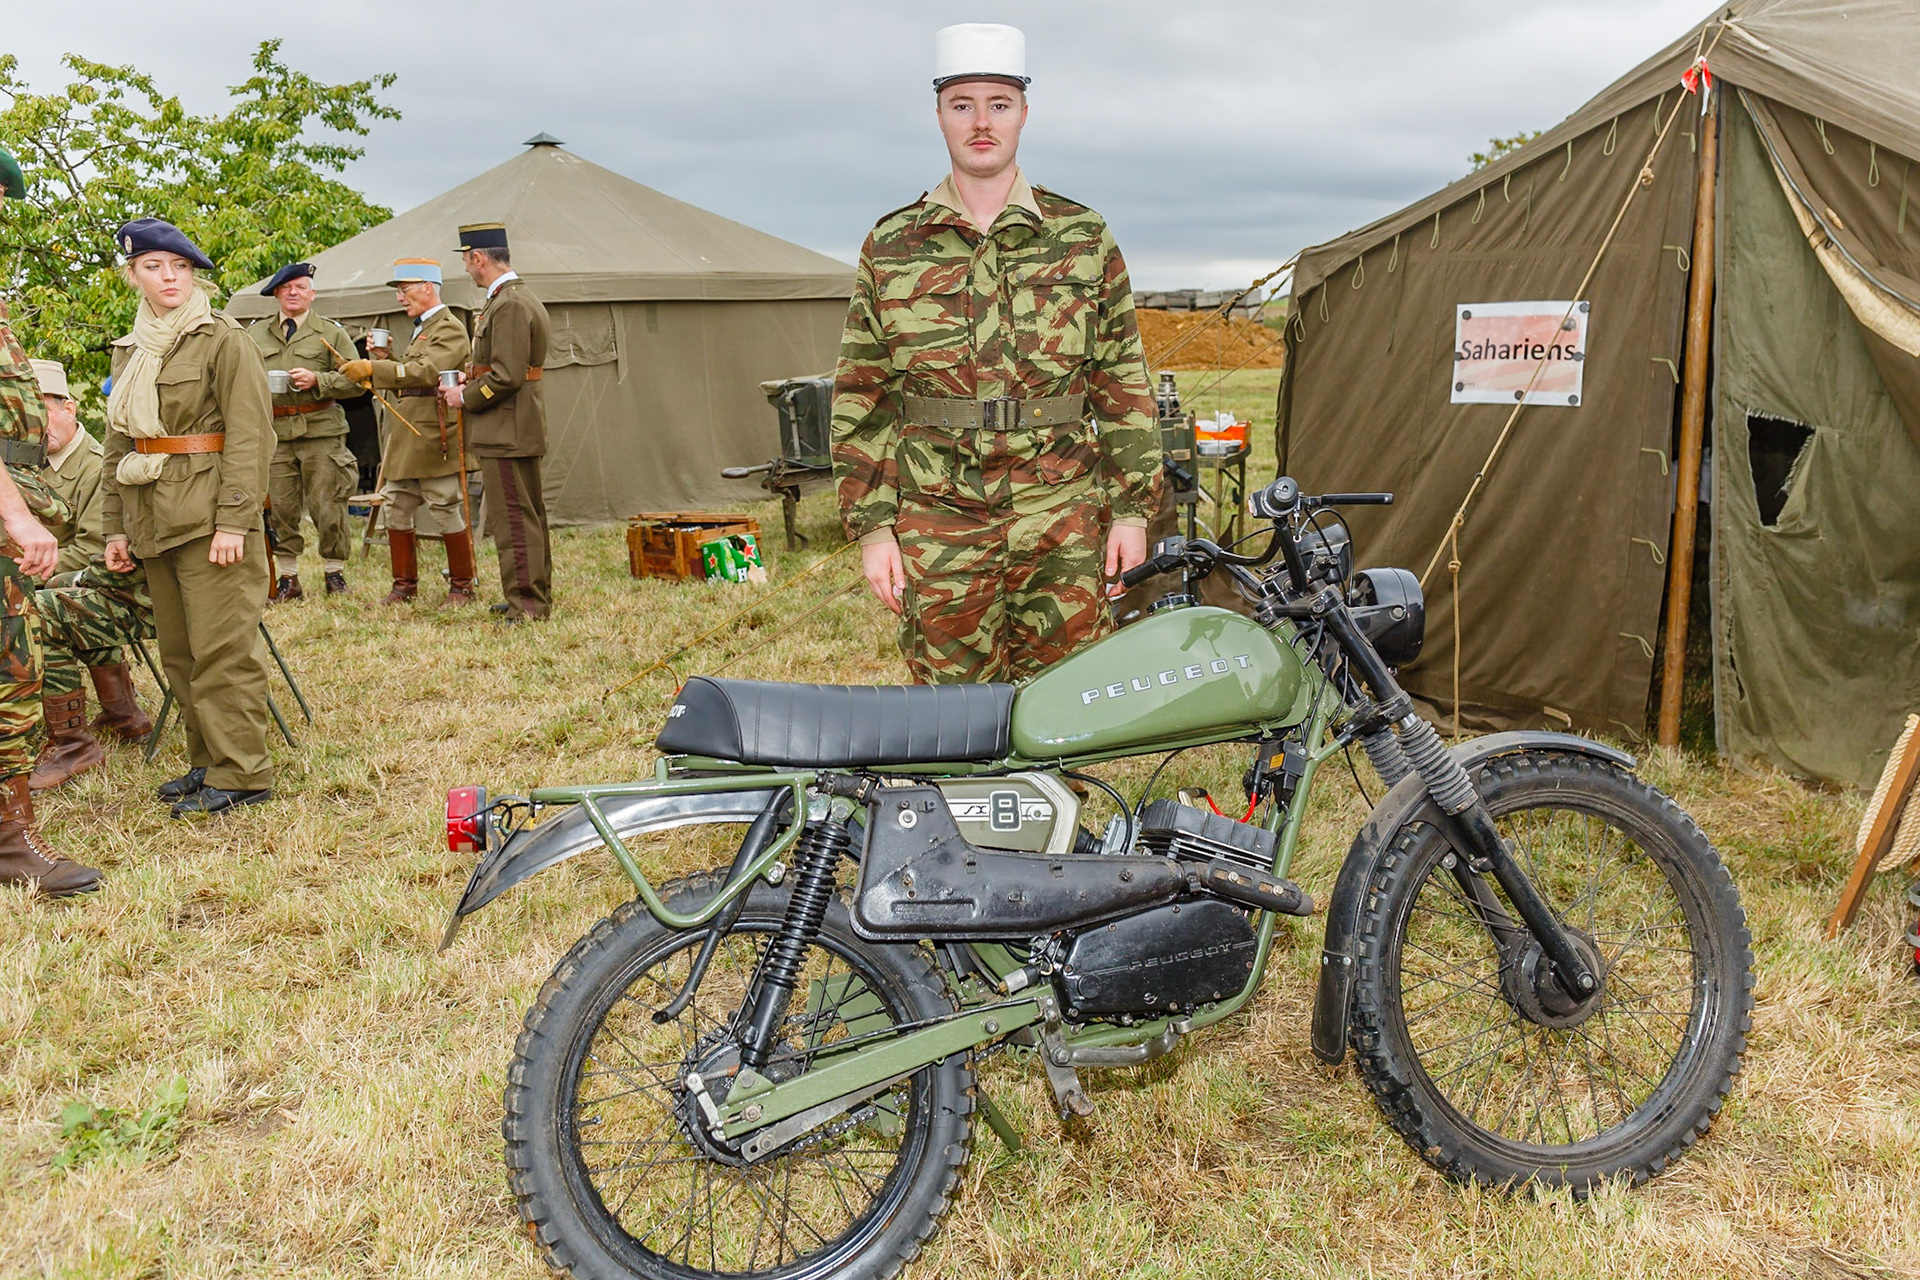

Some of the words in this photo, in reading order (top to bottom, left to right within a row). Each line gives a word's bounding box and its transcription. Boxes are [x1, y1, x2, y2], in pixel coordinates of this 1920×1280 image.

[1460, 338, 1576, 361] Sahariens
[1080, 655, 1250, 706] PEUGEOT
[990, 790, 1022, 832] 8
[1128, 941, 1232, 971] PEUGEOT
